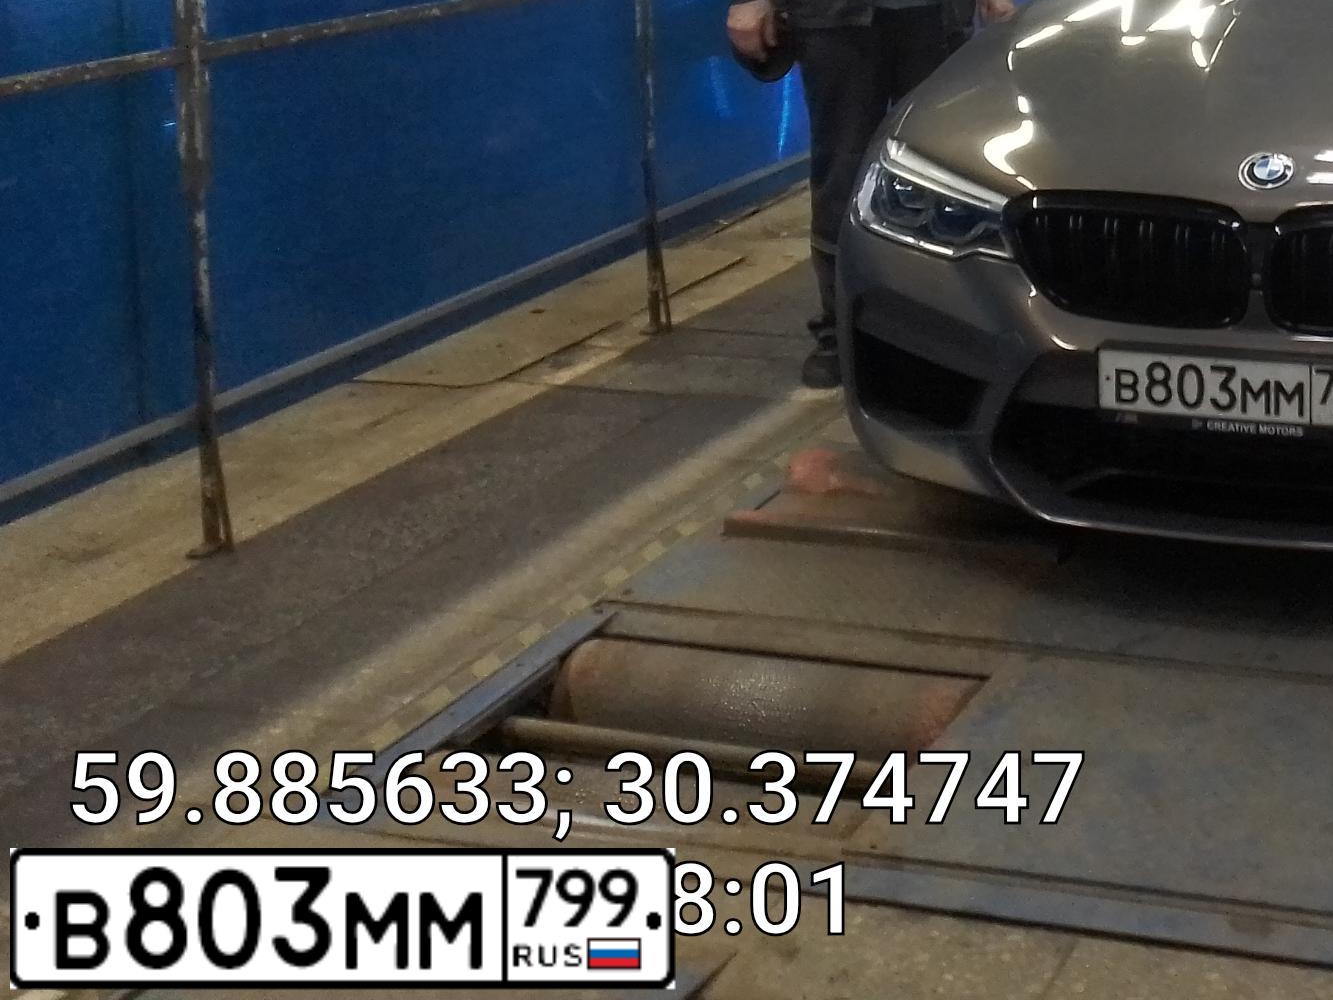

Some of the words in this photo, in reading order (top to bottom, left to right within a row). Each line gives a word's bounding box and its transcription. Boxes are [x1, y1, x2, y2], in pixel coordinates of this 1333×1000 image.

[1113, 360, 1305, 418] В803ММ
[1206, 419, 1257, 434] CREATIVE
[1258, 423, 1304, 438] MOTORS
